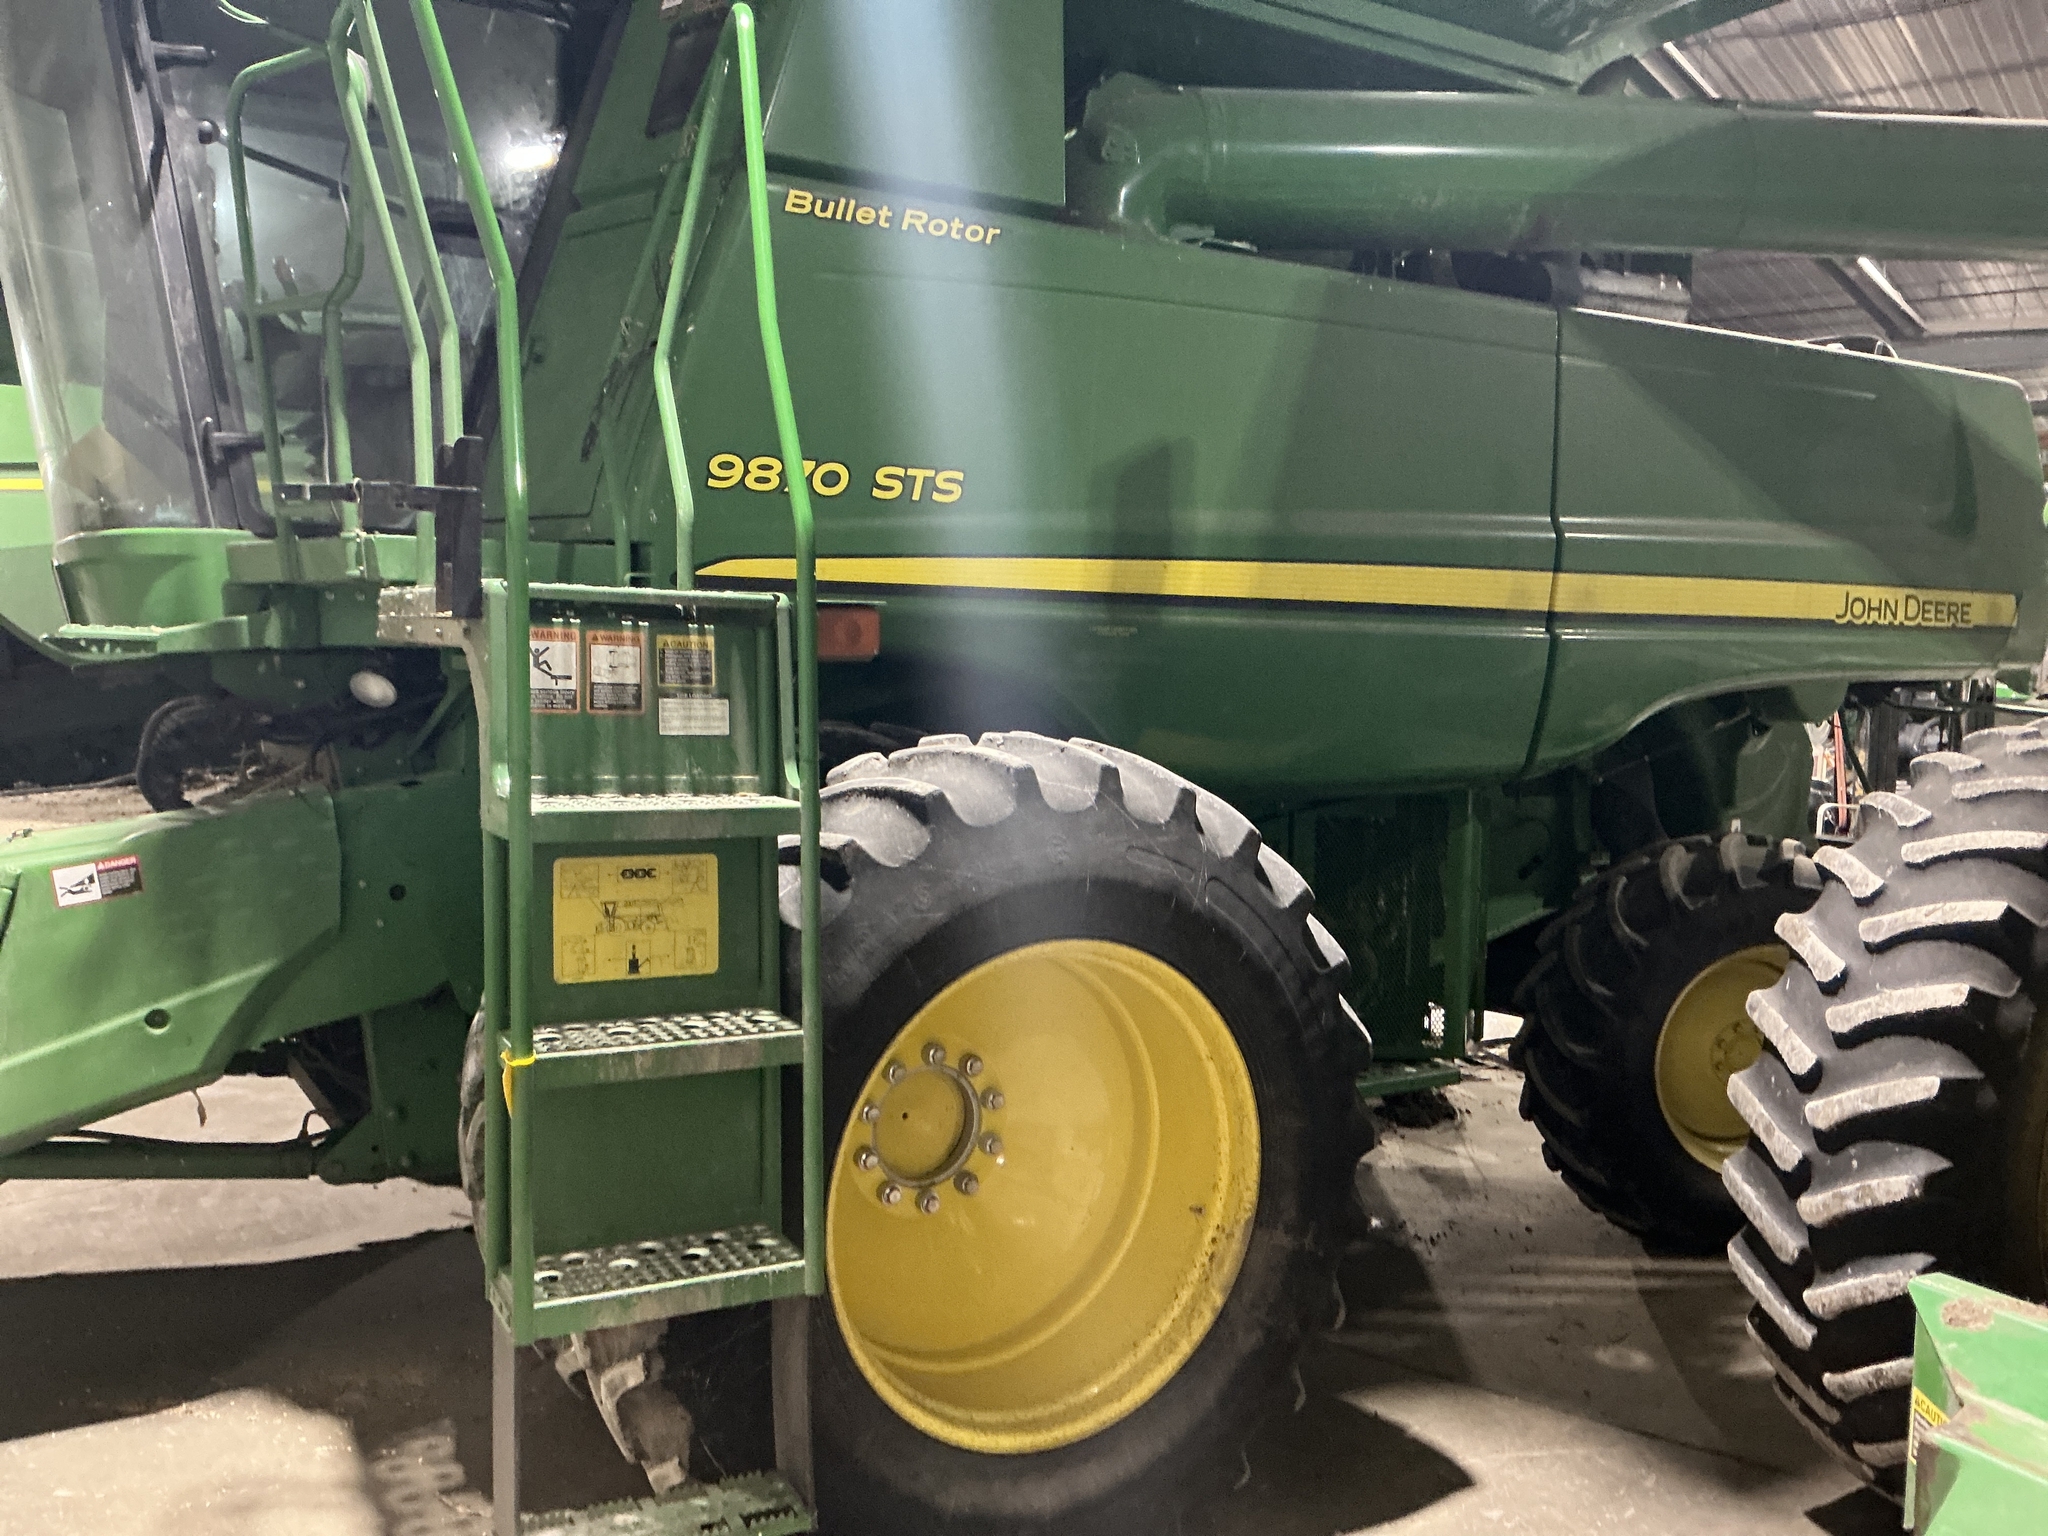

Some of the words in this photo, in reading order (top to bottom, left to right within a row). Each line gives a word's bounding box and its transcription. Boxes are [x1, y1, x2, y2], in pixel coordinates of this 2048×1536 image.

[785, 188, 892, 229] Bullet
[901, 207, 1001, 245] Rotor
[872, 465, 964, 503] STS
[1835, 591, 1899, 621] JOHN
[1904, 594, 1972, 624] DEERE
[531, 629, 577, 640] WARNING
[600, 634, 640, 642] WARNING
[670, 640, 709, 649] CAUTION
[1920, 1399, 1945, 1426] CAUTI
